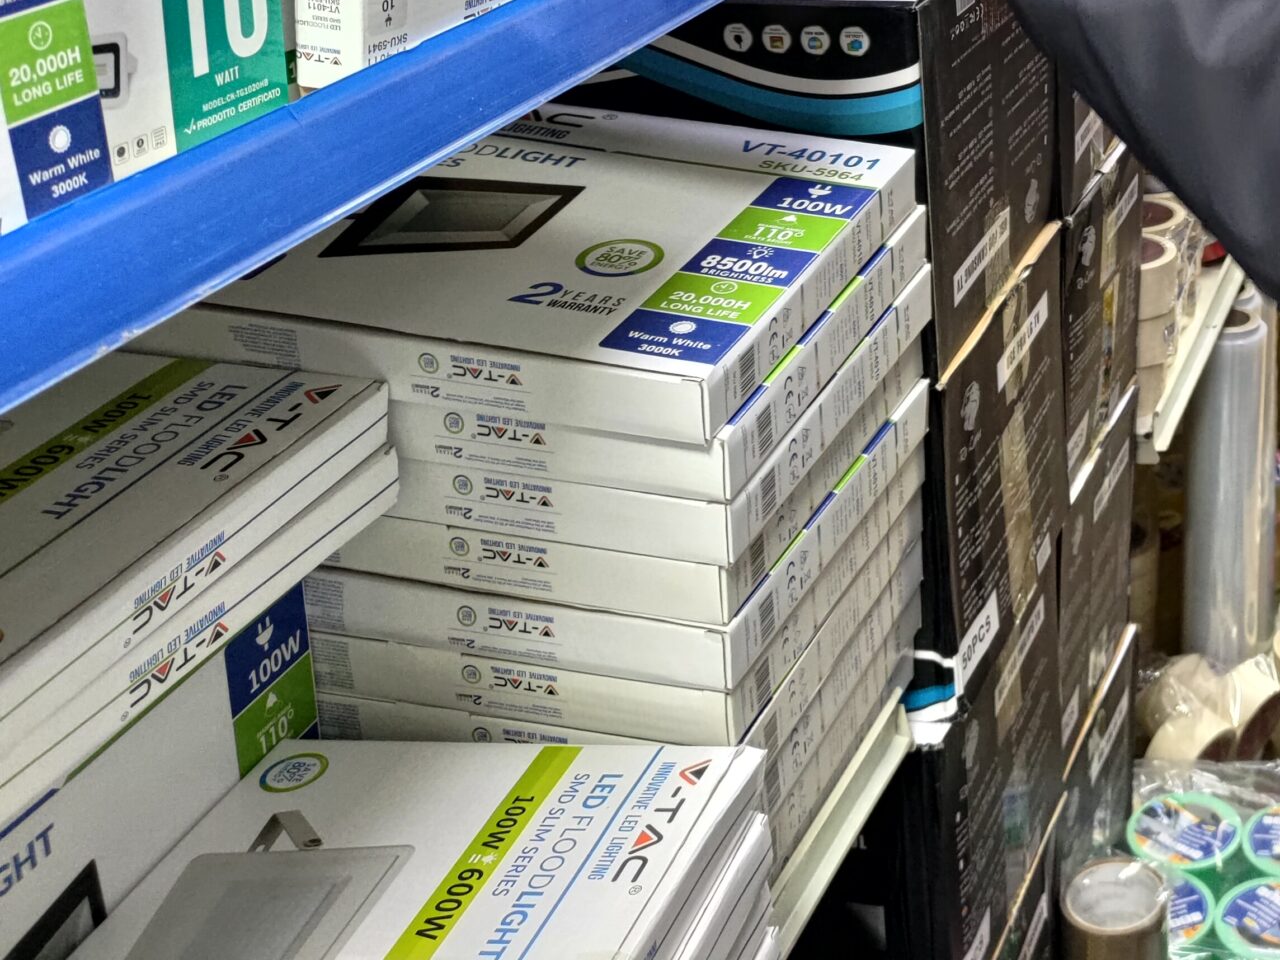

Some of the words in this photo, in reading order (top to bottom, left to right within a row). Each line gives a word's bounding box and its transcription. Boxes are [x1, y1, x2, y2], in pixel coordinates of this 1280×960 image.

[382, 0, 395, 12] 10
[367, 33, 408, 54] SKU-5941
[8, 46, 81, 86] 20,000H
[215, 66, 239, 87] WATT
[14, 81, 53, 106] LONG
[56, 70, 85, 95] LIFE
[197, 107, 235, 130] PRODOTTO
[238, 87, 281, 112] CERTIFICATO
[29, 158, 65, 186] Warm
[68, 148, 101, 173] White
[741, 140, 880, 171] VT-40101
[758, 159, 865, 182] SKU-5964
[52, 176, 88, 198] 3000K
[776, 197, 853, 216] 100W
[595, 254, 642, 267] 80%
[606, 246, 647, 258] SAVE
[700, 255, 789, 279] 8500lm
[701, 268, 774, 284] BRIGHTNESS
[507, 282, 564, 306] 2
[559, 289, 627, 307] YEARS
[669, 291, 752, 311] 20,000H
[546, 298, 618, 317] WARRANTY
[660, 301, 705, 314] LONG
[707, 308, 742, 319] LIFE
[628, 330, 668, 343] Warm
[672, 338, 711, 350] White
[637, 343, 683, 357] 3000K
[452, 365, 523, 386] V-TAC
[173, 381, 215, 405] SMD
[196, 384, 248, 411] LED
[254, 381, 306, 418] INNOVATIVE
[82, 392, 153, 433] 100W
[132, 406, 178, 432] SLIM
[200, 384, 342, 472] V-TAC
[225, 419, 253, 433] LED
[477, 424, 546, 445] V-TAC
[76, 433, 138, 470] SERIES
[177, 434, 232, 467] LIGHTING
[41, 413, 203, 520] FLOODLIGHT
[485, 486, 553, 508] V-TAC
[185, 531, 225, 571] INNOVATIVE
[483, 548, 549, 568] V-TAC
[165, 564, 183, 584] LED
[133, 551, 226, 635] V-TAC
[134, 574, 167, 610] LIGHTING
[488, 618, 555, 638] V-TAC
[961, 615, 991, 670] 50PCS
[130, 621, 228, 708] V-TAC
[249, 630, 301, 694] 100W
[494, 676, 559, 696] V-TAC
[556, 774, 590, 806] SMD
[582, 774, 624, 810] LED
[640, 761, 677, 811] INNOVATIVE
[481, 795, 534, 851] 100W
[532, 808, 563, 842] SLIM
[611, 759, 712, 883] V-TAC
[616, 814, 642, 833] LED
[588, 835, 623, 881] LIGHTING
[492, 846, 537, 898] SERIES
[478, 814, 594, 960] FLOODLIGHT
[414, 868, 484, 941] 600W
